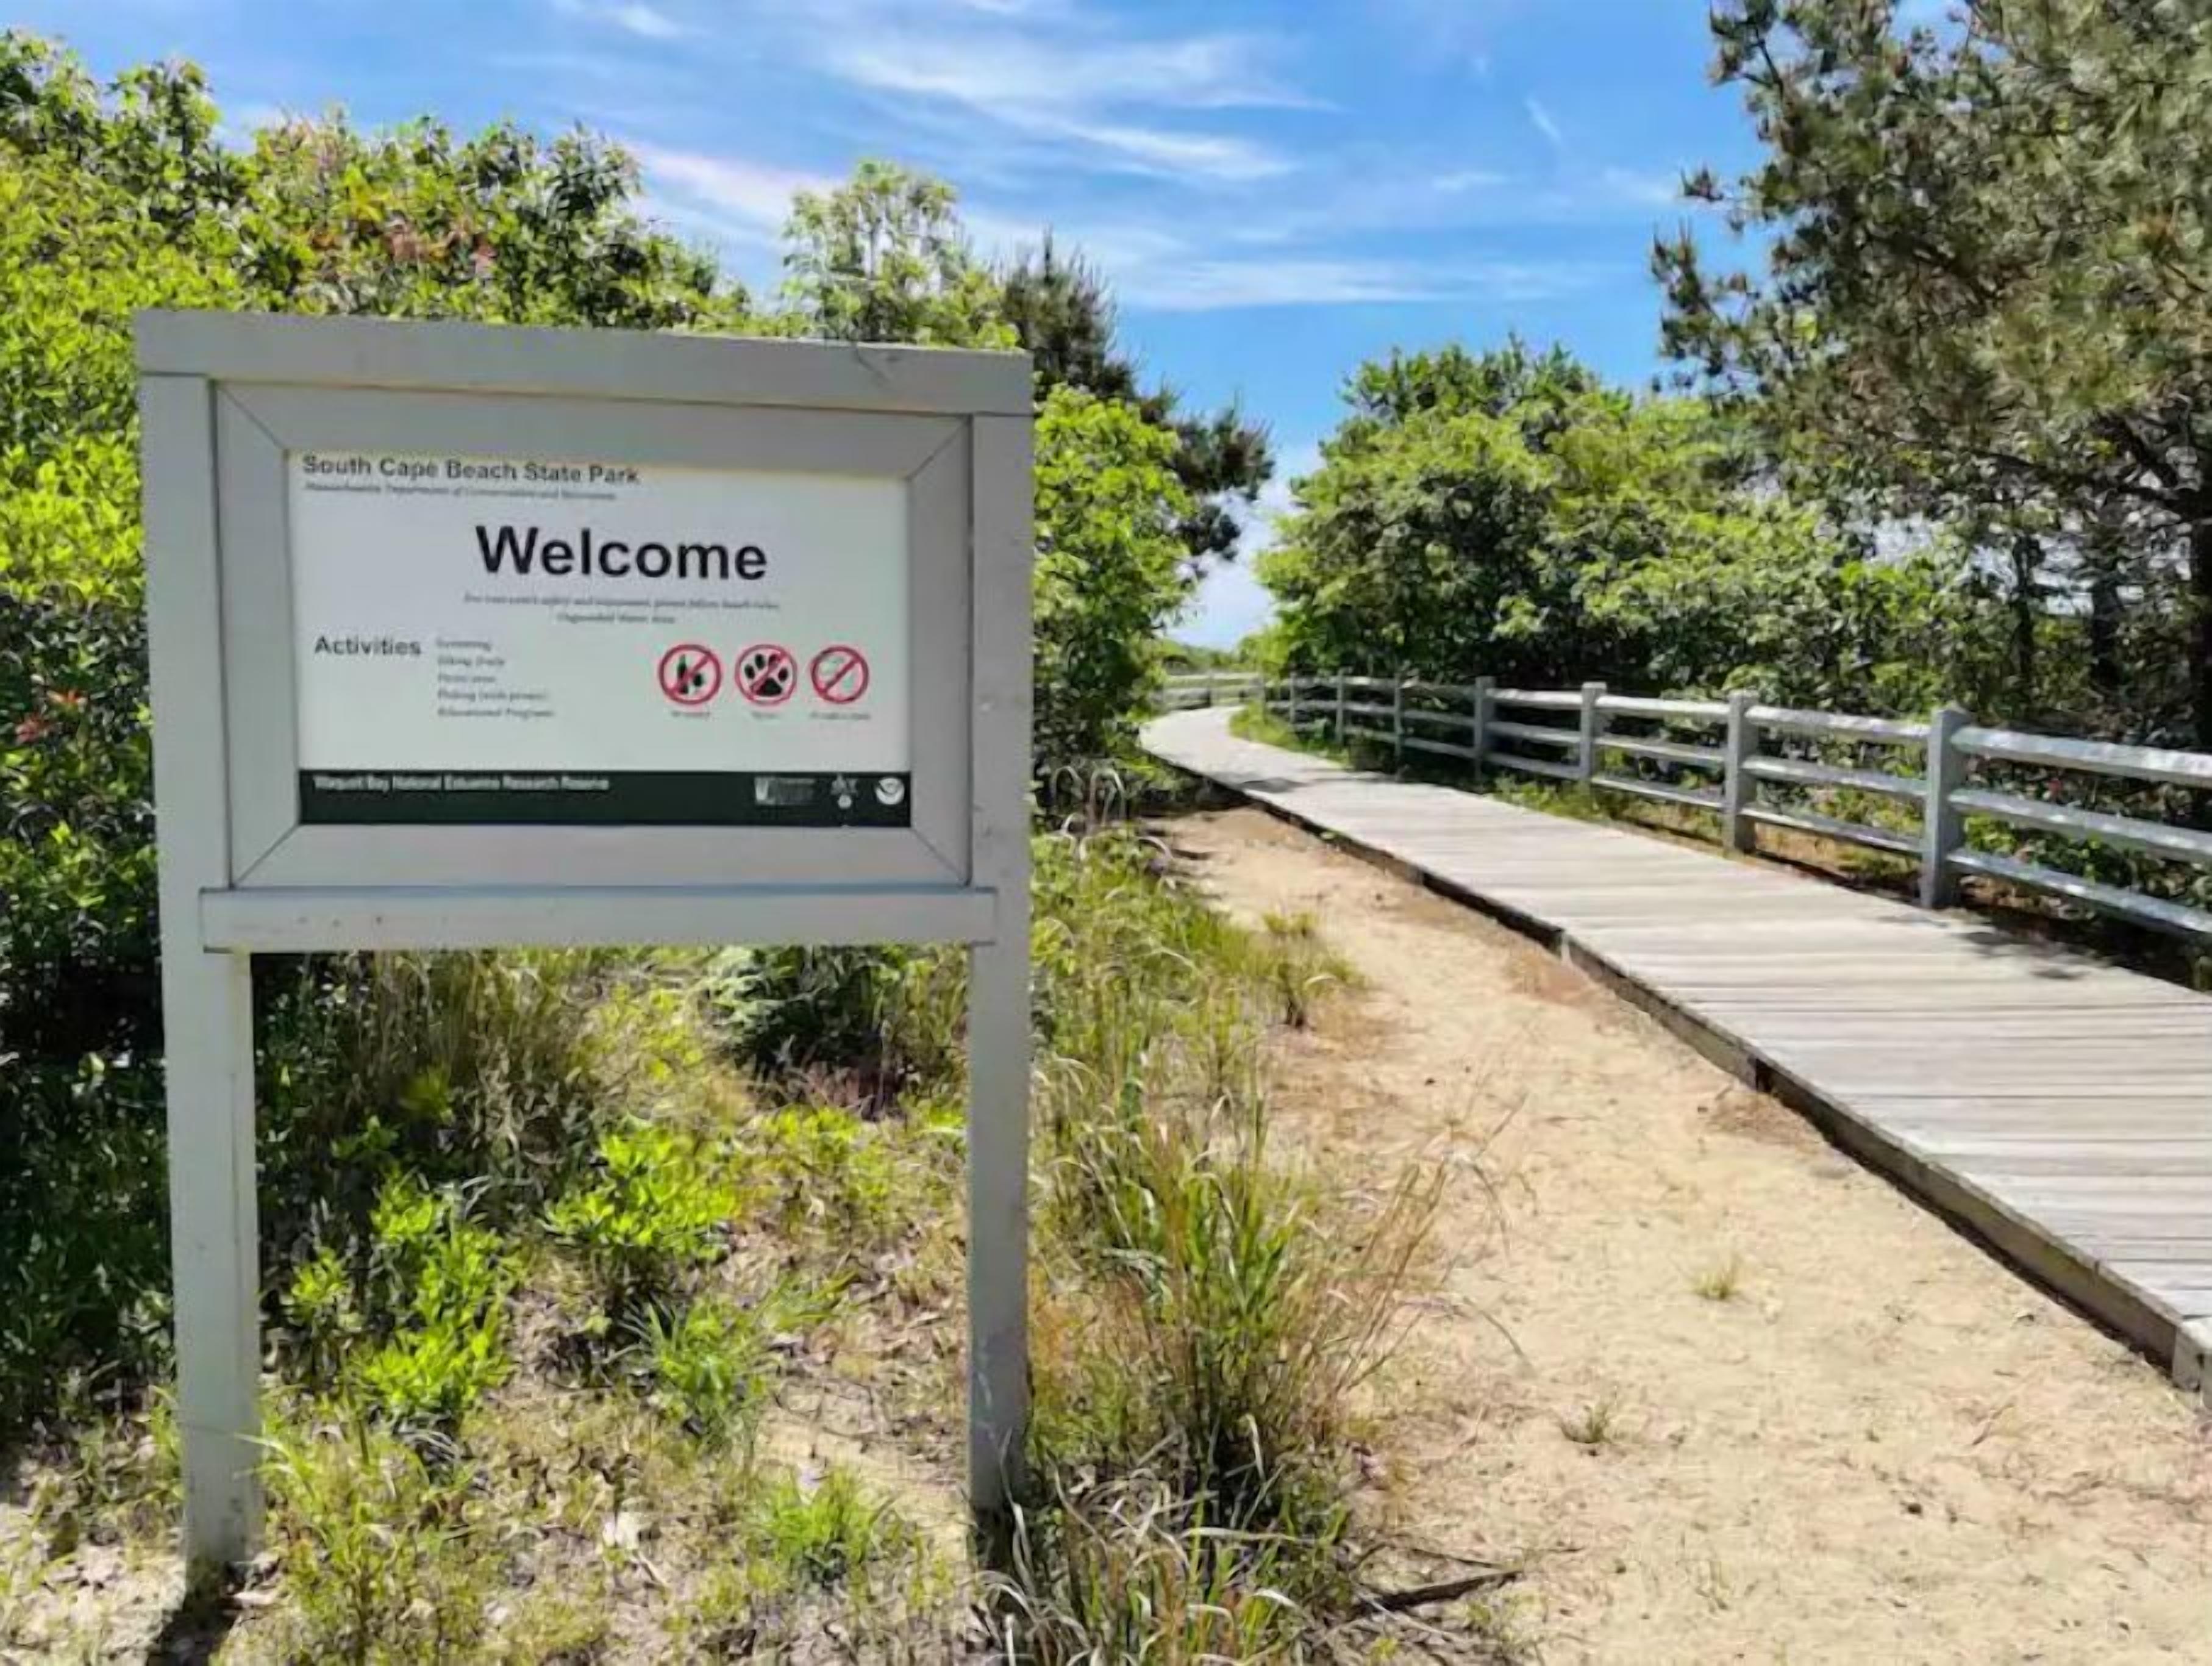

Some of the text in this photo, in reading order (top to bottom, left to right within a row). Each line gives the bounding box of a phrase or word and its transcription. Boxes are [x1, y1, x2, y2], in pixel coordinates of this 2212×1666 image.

[302, 455, 641, 483] South Cape Beach State Park
[476, 525, 767, 580] Welcome
[314, 635, 421, 656] Activities
